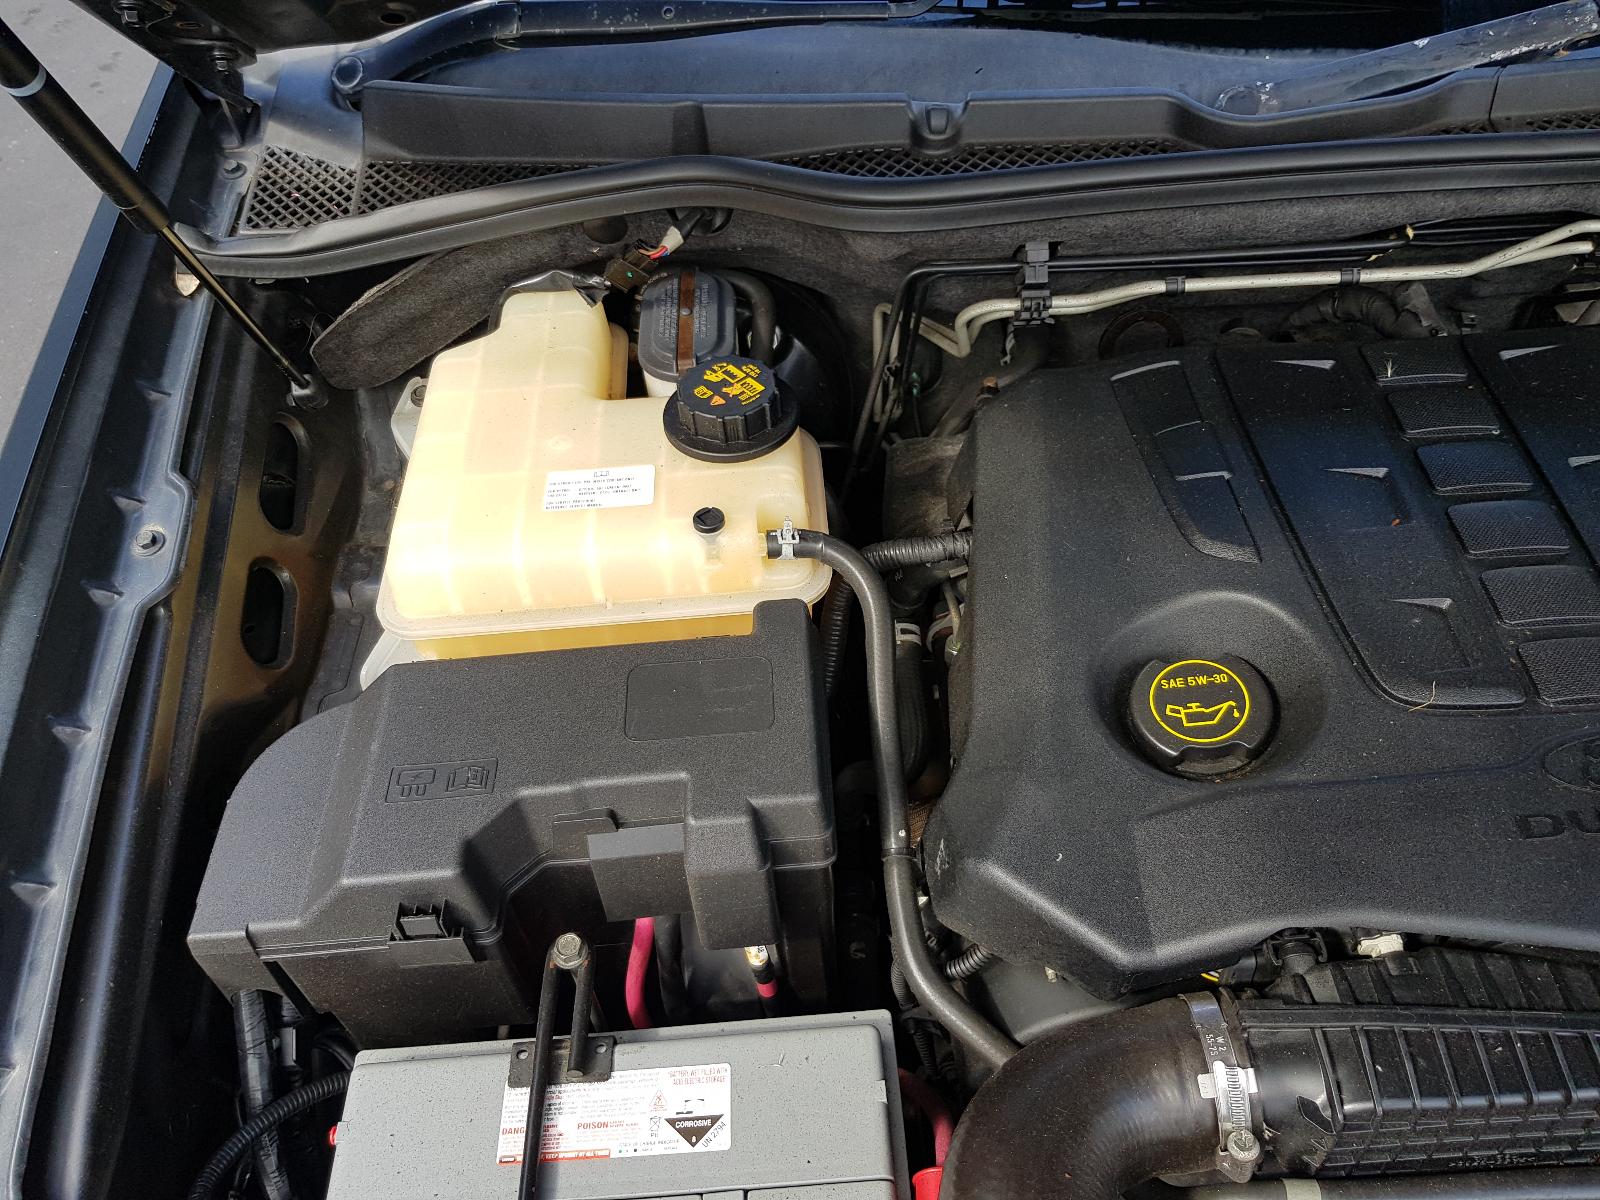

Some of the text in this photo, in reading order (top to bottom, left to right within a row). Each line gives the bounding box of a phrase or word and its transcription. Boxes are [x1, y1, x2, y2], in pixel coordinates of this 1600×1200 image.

[1160, 673, 1227, 689] SAE 5W-30
[577, 1120, 609, 1130] POISON
[675, 1119, 712, 1128] CORROSIVE
[502, 1127, 525, 1136] DANG
[702, 1136, 713, 1148] UN
